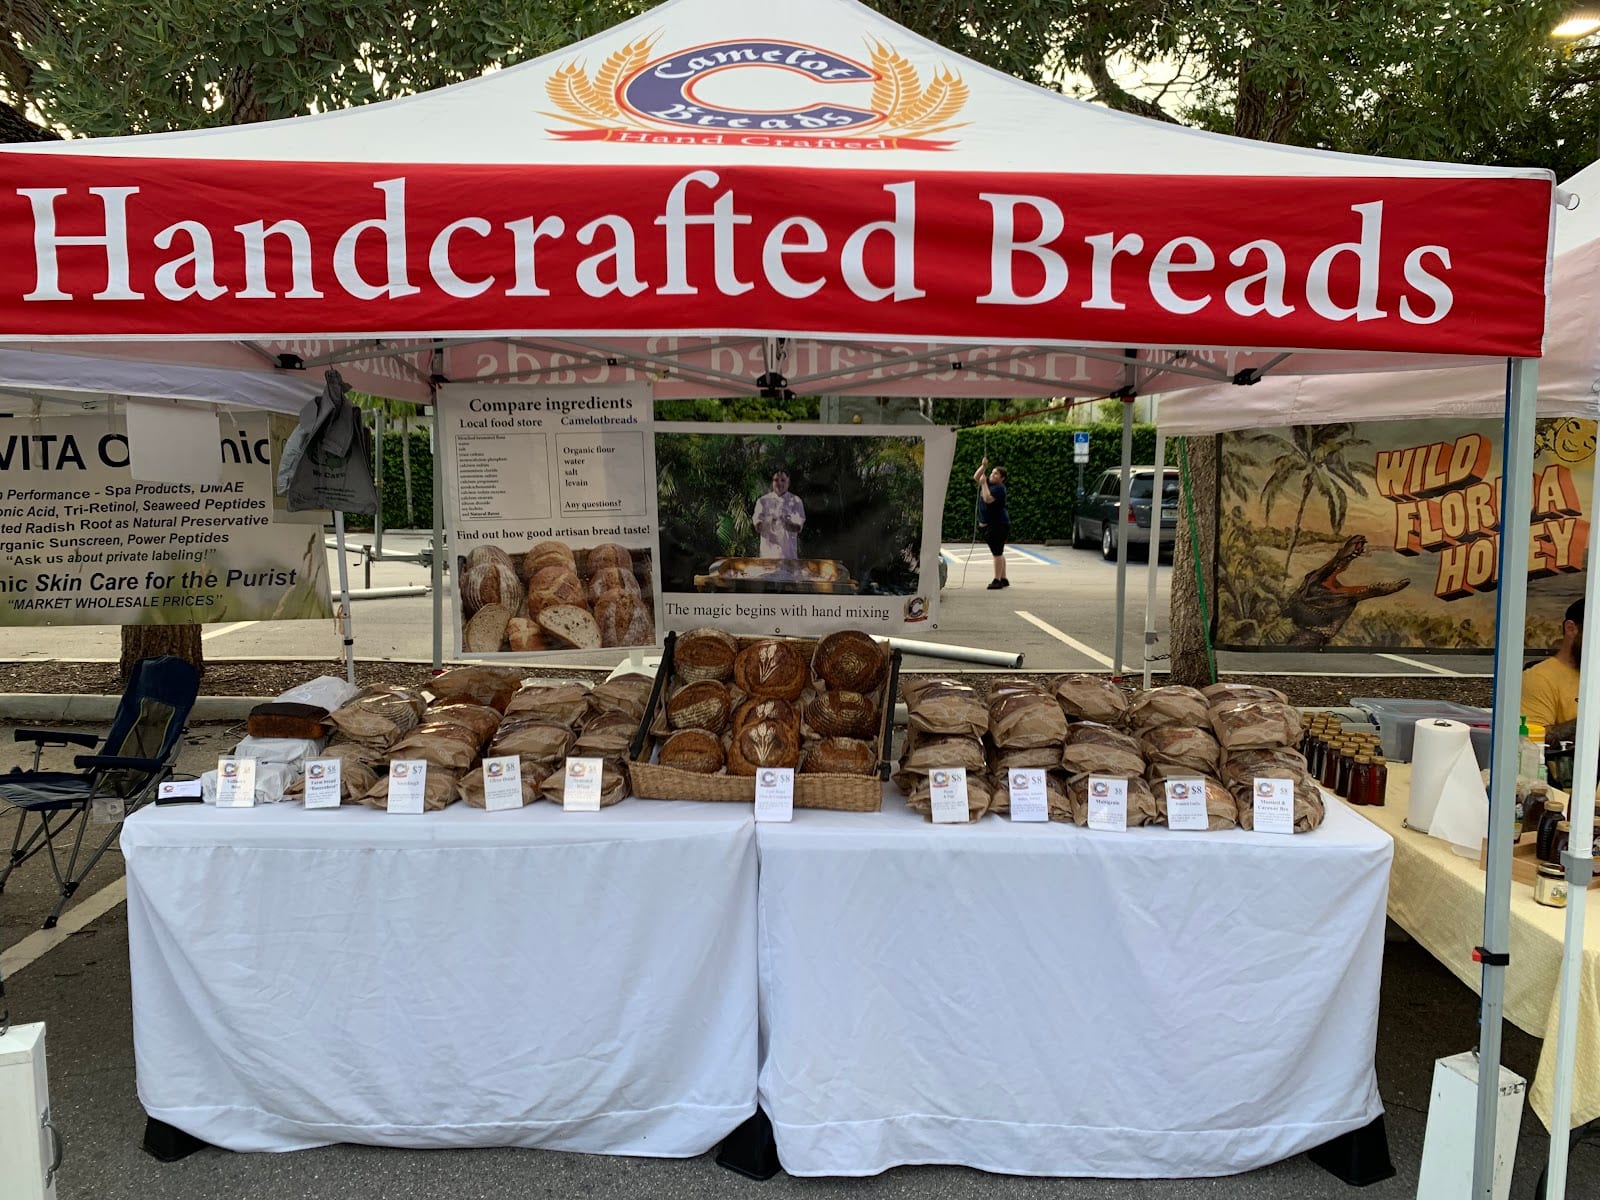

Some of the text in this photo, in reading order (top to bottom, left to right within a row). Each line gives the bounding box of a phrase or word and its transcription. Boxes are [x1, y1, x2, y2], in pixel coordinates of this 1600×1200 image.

[654, 49, 856, 79] Camelot
[650, 103, 853, 130] Breads
[616, 131, 886, 150] Hand Crafted
[16, 170, 1455, 326] Handcrafted Breads
[469, 396, 633, 415] Compare ingredients
[460, 417, 543, 429] Local food store
[561, 414, 638, 426] Camelotbreads
[563, 445, 615, 455] Organic flour
[564, 468, 578, 476] salt
[1376, 433, 1490, 501] WILD
[565, 479, 588, 487] levain
[7, 489, 90, 501] Performance
[105, 485, 131, 498] Spa
[135, 483, 195, 495] Products,
[27, 506, 59, 518] Acid,
[64, 501, 139, 517] Tri-Retinol,
[143, 499, 200, 512] Seaweed
[205, 498, 266, 512] Peptides
[565, 499, 622, 509] Any questions?
[25, 522, 75, 534] Radish
[80, 518, 112, 530] Root
[115, 520, 129, 529] as
[133, 517, 177, 529] Natural
[181, 514, 269, 527] Preservative
[49, 538, 124, 548] Sunscreen,
[127, 534, 166, 545] Power
[169, 532, 230, 546] Peptides
[456, 525, 650, 541] Find out how good artisan bread taste!
[46, 555, 63, 564] us
[67, 551, 103, 563] about
[106, 551, 148, 565] private
[35, 573, 82, 592] Skin
[90, 572, 139, 591] Care
[145, 571, 175, 590] for
[182, 570, 218, 589] the
[226, 568, 297, 587] Purist
[76, 596, 159, 608] WHOLESALE
[665, 602, 890, 619] The magic begins with hand mixing
[412, 764, 423, 775] $7
[780, 774, 791, 784] $8
[951, 773, 962, 783] $8
[1031, 775, 1042, 785] $8
[1191, 785, 1202, 795] $8
